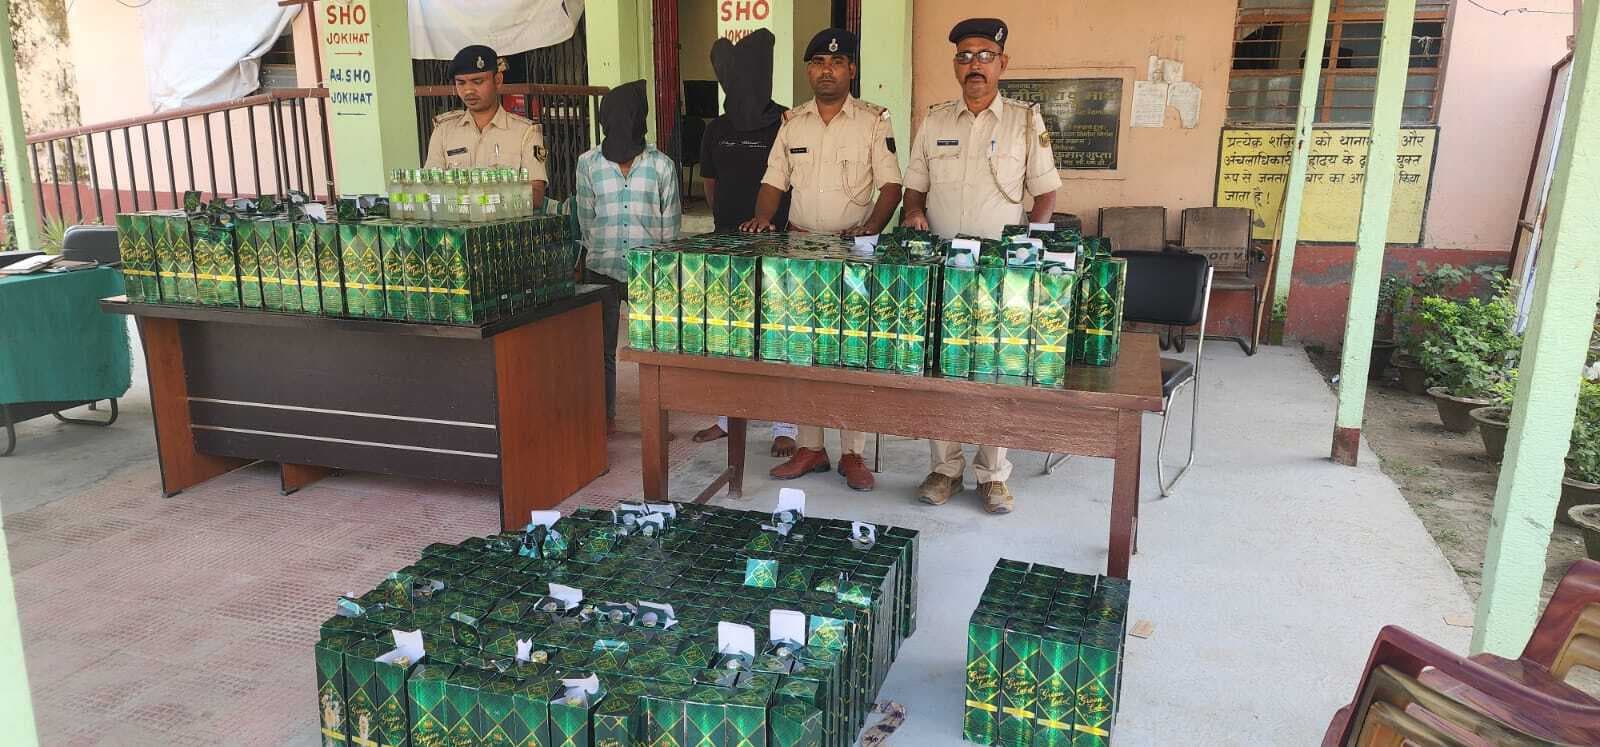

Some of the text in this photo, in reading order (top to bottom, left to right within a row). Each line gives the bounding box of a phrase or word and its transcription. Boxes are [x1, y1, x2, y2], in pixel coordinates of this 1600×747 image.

[326, 4, 366, 25] SHO
[721, 0, 770, 21] SHO
[326, 33, 370, 45] JOKIHAT
[331, 92, 373, 104] JOKIHAT
[1226, 132, 1263, 147] प्रत्येक
[1268, 134, 1296, 148] शनि
[1315, 131, 1332, 147] को
[1401, 130, 1425, 147] और
[1342, 150, 1355, 165] के
[1258, 173, 1288, 185] जनता
[1329, 173, 1345, 184] का
[1224, 190, 1251, 201] जाता
